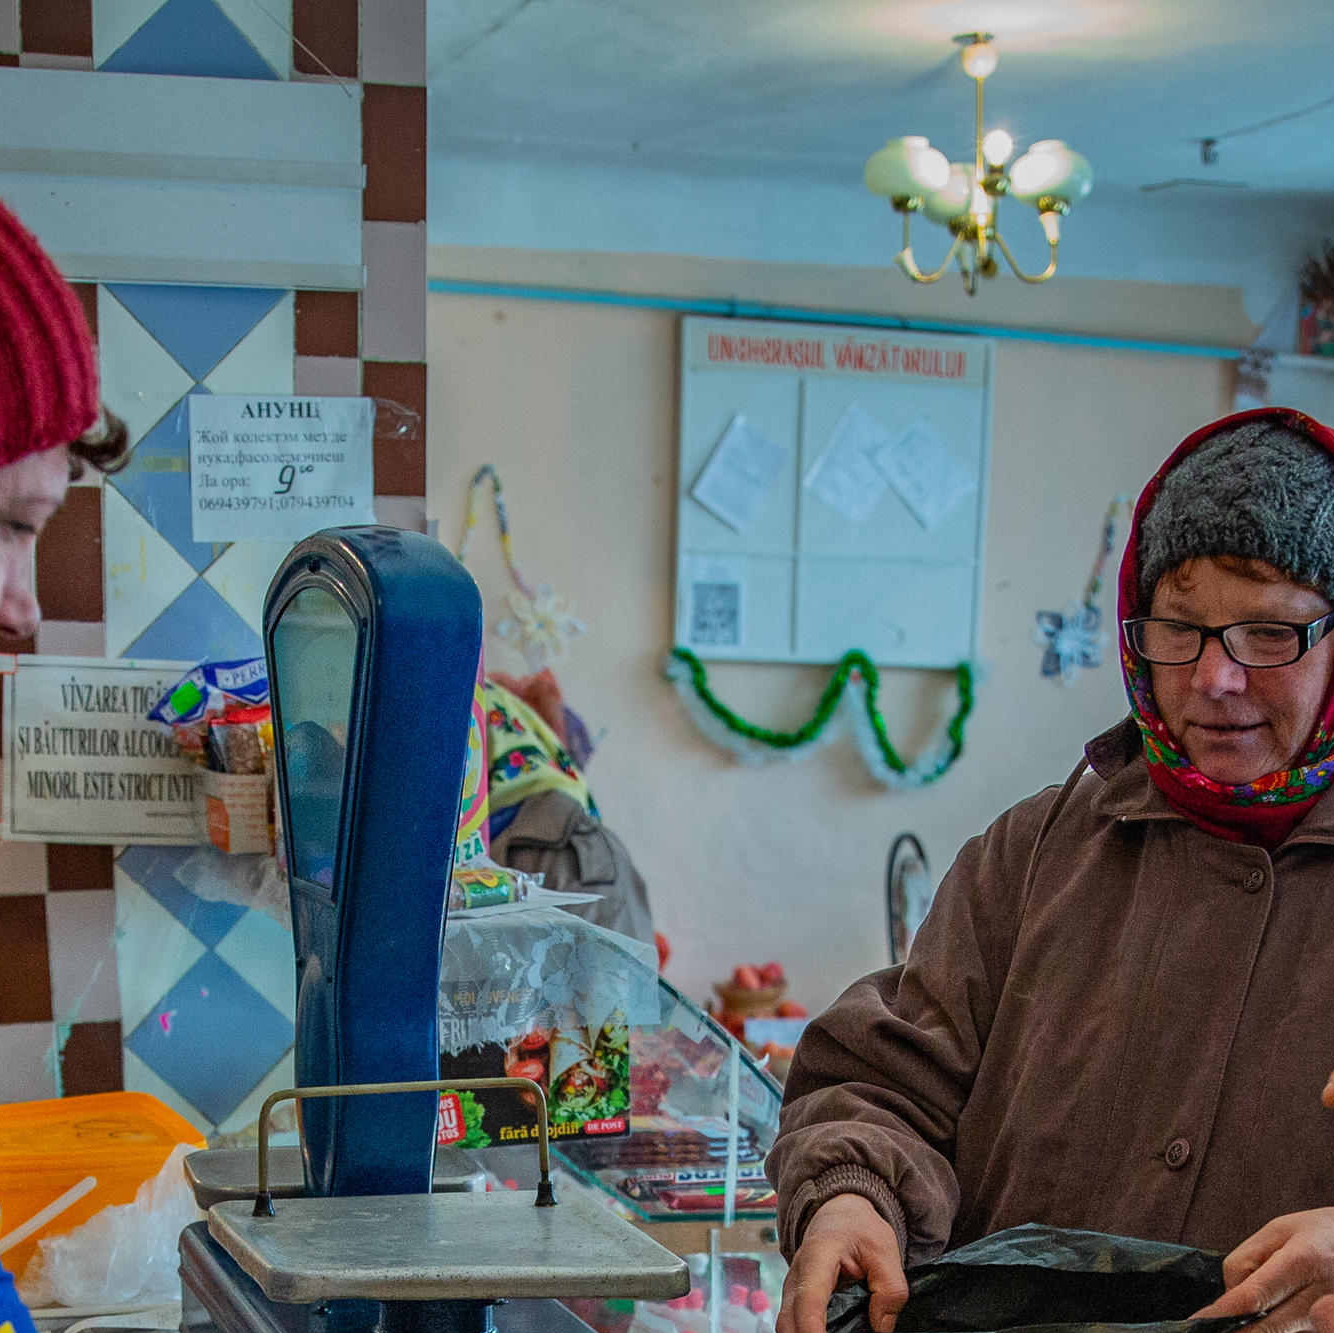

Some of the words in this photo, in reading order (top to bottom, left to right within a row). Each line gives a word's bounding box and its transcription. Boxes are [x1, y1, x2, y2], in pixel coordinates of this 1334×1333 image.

[241, 402, 321, 420] АНУНЦ
[61, 677, 128, 714] VÎNZAREA
[34, 720, 121, 757] BĂUTURILOR
[84, 772, 115, 801] ESTE
[118, 773, 165, 802] STRICT
[499, 1125, 528, 1140] fără
[601, 1120, 623, 1131] POST
